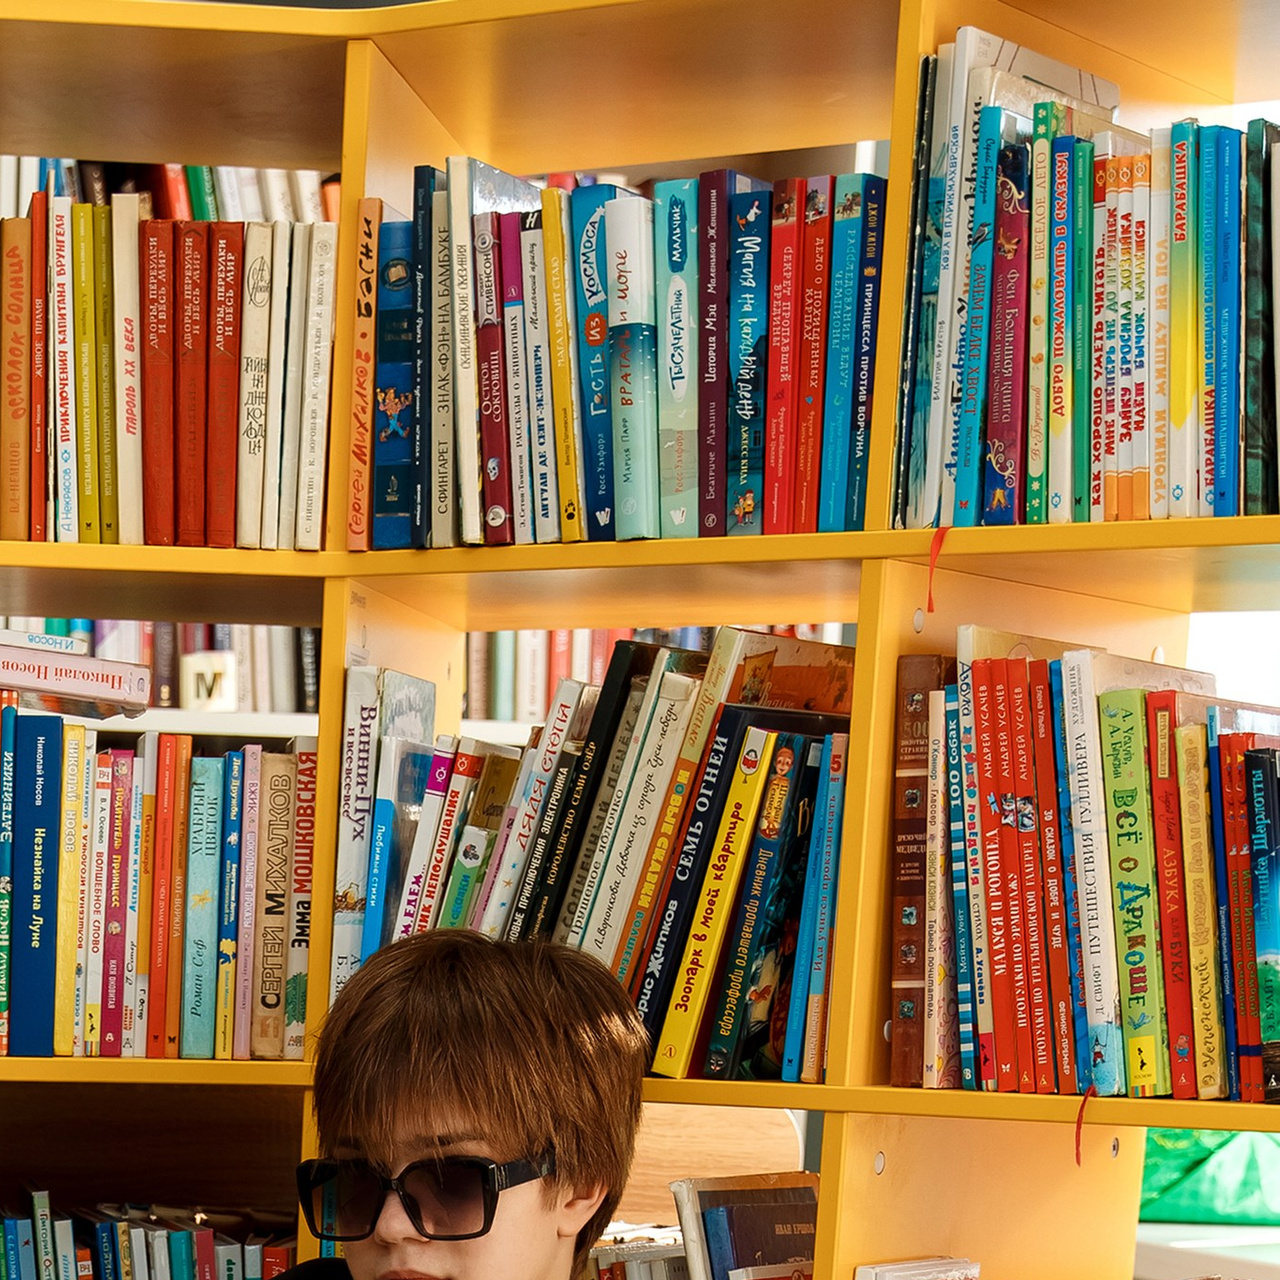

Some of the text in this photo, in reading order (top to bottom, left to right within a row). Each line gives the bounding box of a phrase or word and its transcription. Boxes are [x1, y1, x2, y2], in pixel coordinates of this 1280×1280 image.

[1173, 141, 1187, 243] БАРАБАШКА
[149, 237, 159, 349] ДВОРЫ, ПЕРЕУЛКИ
[158, 250, 166, 281] МИР
[158, 287, 166, 322] ВЕСЬ
[482, 253, 495, 314] СТИВЕНСОН
[1052, 152, 1069, 417] ДОБРО ПОЖАЛОВАТЬ В СКАЗКУ!
[34, 299, 44, 377] ЖИВОЕ ПЛАМЯ
[54, 215, 70, 442] ПРИКЛЮЧЕНИЯ КАПИТАНА ВРУНГЕЛЯ
[438, 302, 450, 324] НА
[705, 304, 717, 382] История Мэй
[480, 362, 491, 414] ОСТРОВ
[490, 350, 502, 422] СОКРОВИЩ
[706, 402, 716, 499] Беатриче Мазини
[1, 660, 49, 682] Носов
[53, 665, 124, 690] Николай
[979, 685, 993, 778] АНДРЕЙ УСАЧЕВ
[191, 781, 205, 856] ХРАБРЫЙ
[205, 796, 219, 856] ЦВЕТОК
[676, 734, 730, 882] СЕМЬ ОГНЕЙ
[707, 801, 745, 882] квартире
[1073, 732, 1101, 956] ПУТЕШЕСТВИЯ ГУЛЛИВЕРА
[31, 828, 46, 948] Незнайка на Луне
[290, 752, 317, 949] Эмма МОШКОВСКАЯ
[261, 774, 291, 1009] СЕРГЕЙ МИХАЛКОВ
[697, 887, 723, 928] моей
[190, 939, 205, 1018] Роман Сеф
[674, 948, 704, 1013] Зоопарк
